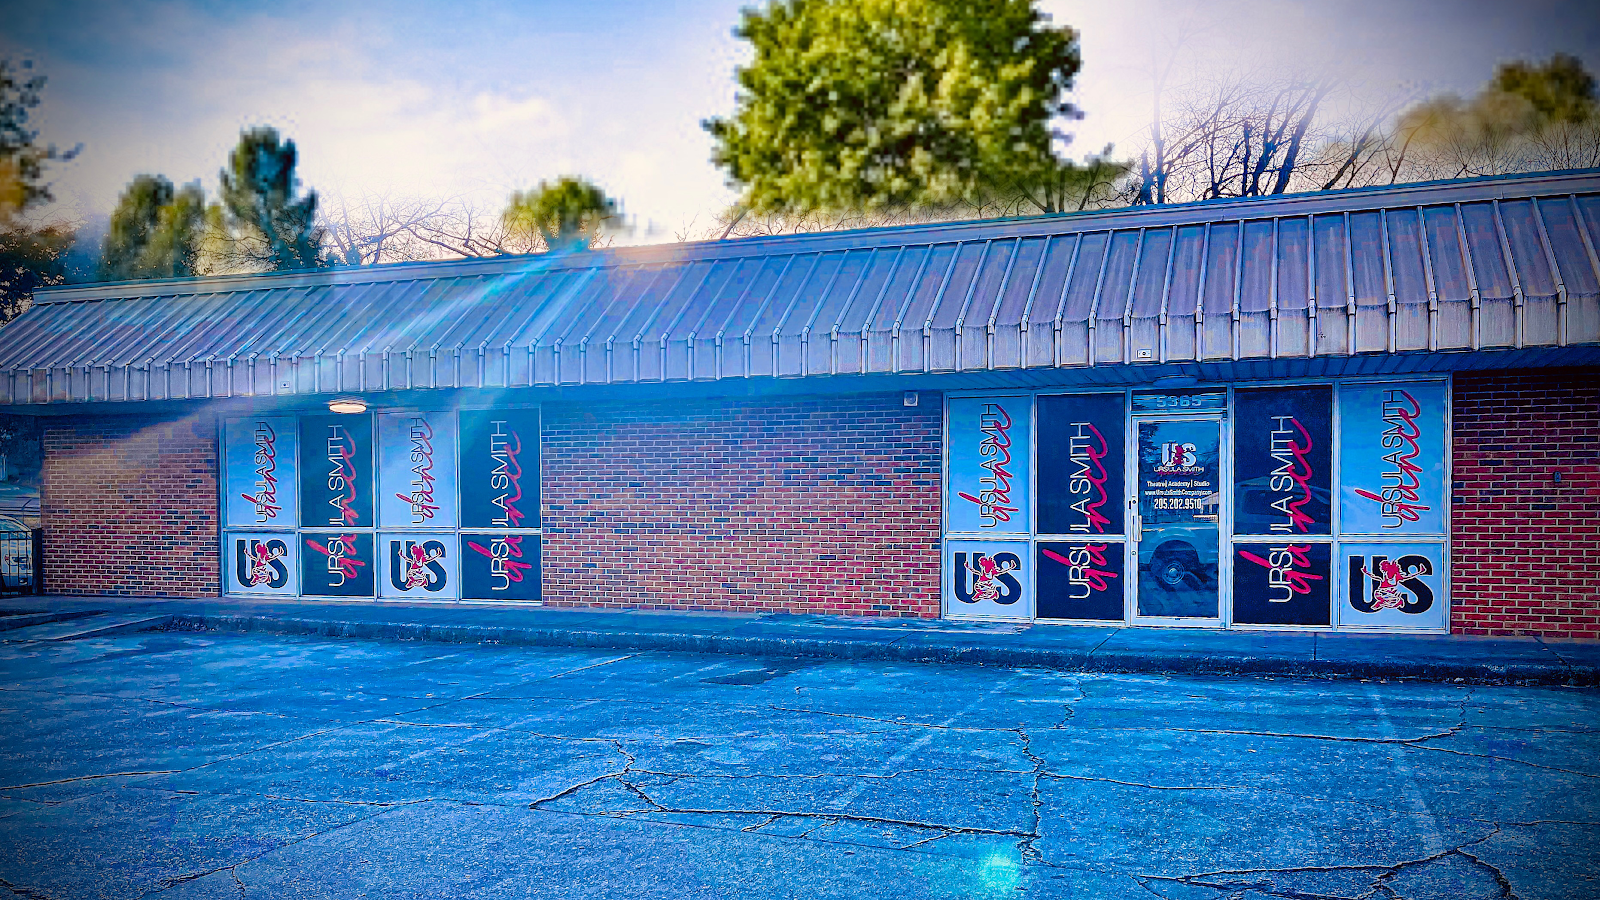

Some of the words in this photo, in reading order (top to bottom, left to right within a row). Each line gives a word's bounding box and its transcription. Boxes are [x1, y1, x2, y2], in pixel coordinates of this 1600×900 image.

[255, 421, 268, 465] SMITH
[410, 417, 424, 463] SMITH
[980, 403, 998, 456] SMITH
[1381, 389, 1403, 449] SMITH
[327, 424, 345, 491] SMITH
[490, 420, 509, 490] SMITH
[1069, 422, 1091, 495] SMITH
[1161, 442, 1197, 467] US
[1269, 415, 1294, 492] SMITH
[255, 466, 268, 523] URSULA
[411, 464, 425, 524] URSULA
[979, 459, 998, 528] URSULA
[1154, 498, 1202, 509] 205.202.9510
[1168, 480, 1190, 488] Academy
[1381, 451, 1403, 529] URSULA
[236, 538, 289, 589] US
[328, 494, 345, 587] URSULA
[390, 540, 447, 592] US
[491, 493, 510, 591] URSULA
[1069, 497, 1091, 599] URSULA
[1268, 495, 1294, 603] URSULA
[954, 551, 1022, 605] US
[1348, 554, 1434, 615] US
